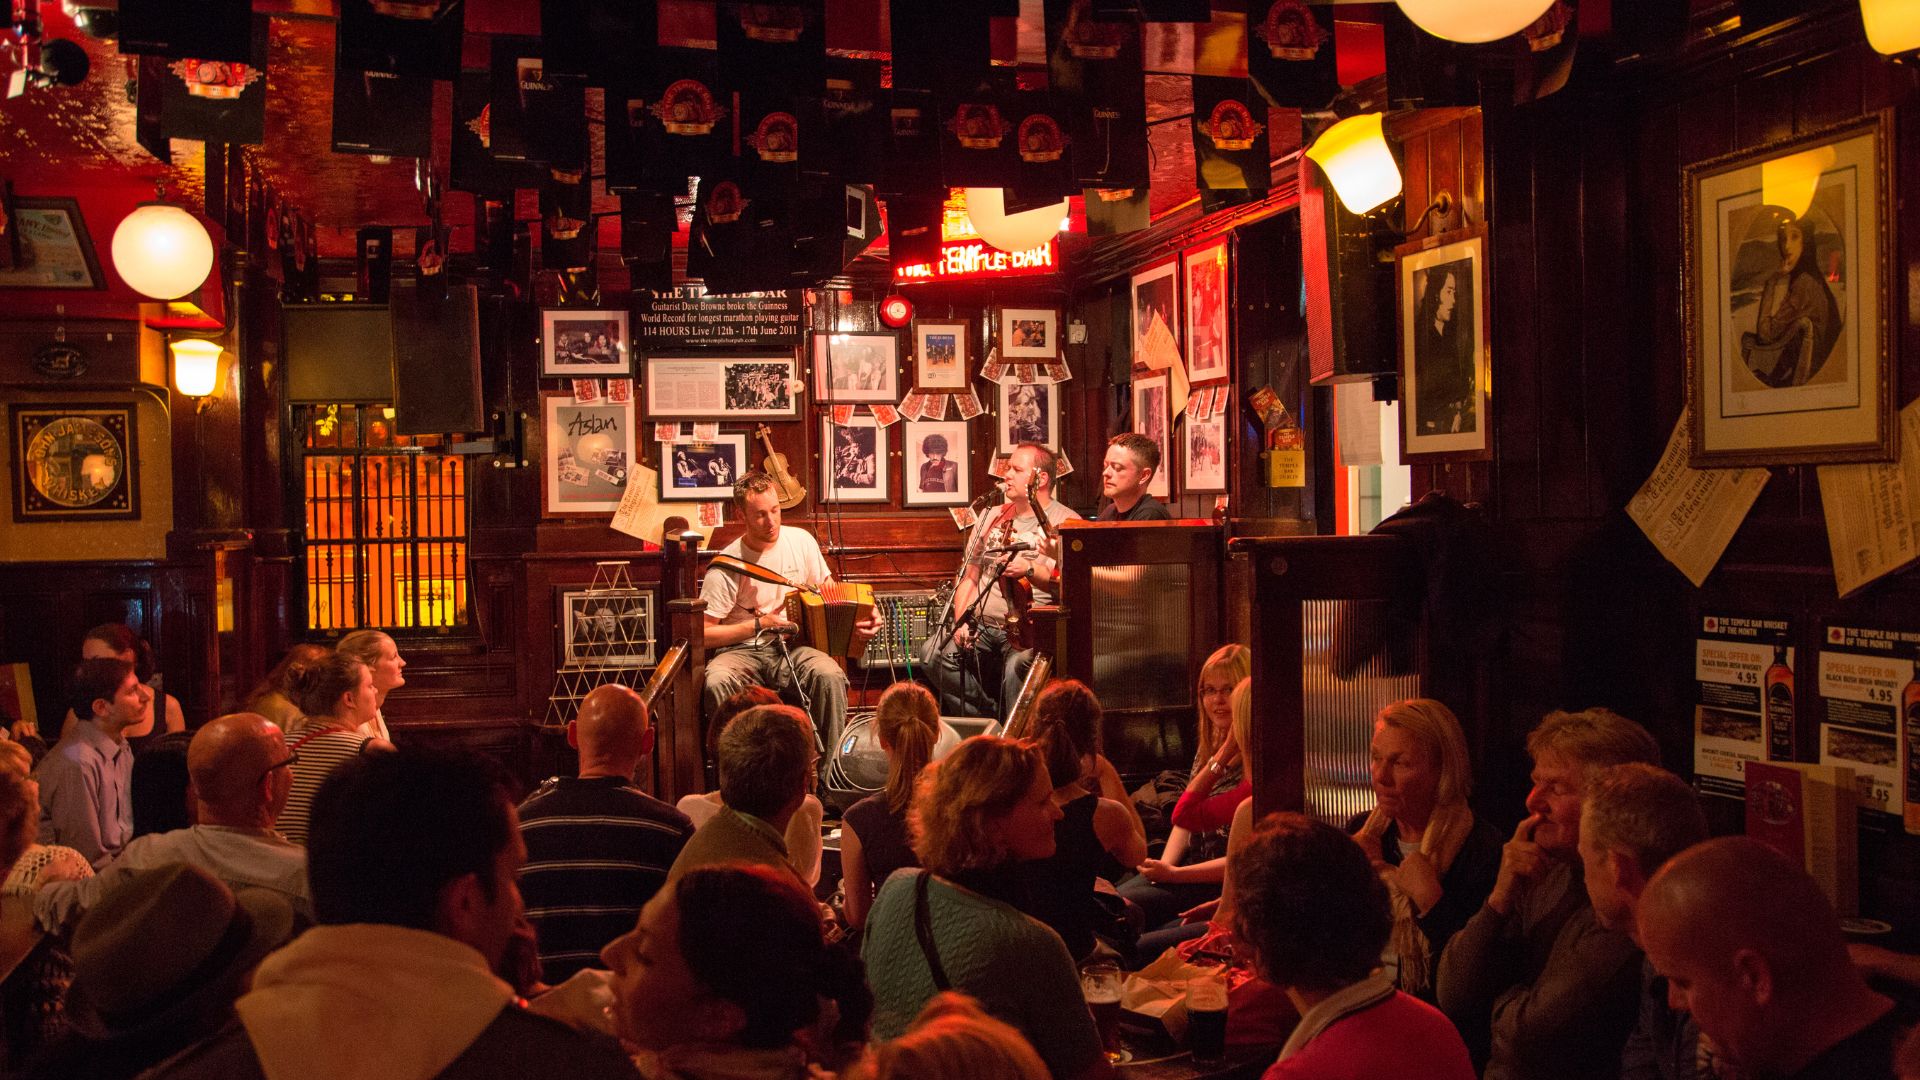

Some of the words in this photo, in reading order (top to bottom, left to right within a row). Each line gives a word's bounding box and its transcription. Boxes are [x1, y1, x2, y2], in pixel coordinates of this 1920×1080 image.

[651, 301, 680, 311] Guitarist
[682, 302, 699, 311] Dave
[700, 301, 725, 311] Browne
[726, 301, 745, 311] broke
[746, 301, 757, 310] the
[758, 301, 788, 310] Guinness
[641, 314, 660, 323] World
[662, 314, 685, 323] Record
[687, 314, 697, 323] for
[699, 313, 722, 325] longest
[723, 314, 753, 323] marathon
[754, 313, 778, 325] playing
[780, 313, 799, 325] guitar
[644, 326, 656, 336] 114
[659, 326, 690, 336] HOURS
[692, 326, 709, 336] Live
[718, 325, 733, 335] 12th
[743, 325, 758, 335] 17th
[760, 325, 777, 335] June
[779, 325, 797, 335] 2011
[567, 411, 618, 436] Aslan
[1719, 617, 1730, 626] THE
[1730, 618, 1751, 628] TEMPLE
[1751, 619, 1763, 629] BAR
[1763, 620, 1788, 631] WHISKEY
[1719, 626, 1726, 635] OF
[1727, 626, 1738, 636] THE
[1738, 627, 1758, 637] MONTH
[1846, 627, 1858, 638] THE
[1860, 629, 1884, 640] TEMPLE
[1885, 631, 1899, 641] BAR
[1846, 637, 1855, 646] OF
[1856, 638, 1869, 648] THE
[1869, 639, 1894, 650] MONTH
[1702, 649, 1727, 660] SPECIAL
[1728, 651, 1749, 662] OFFER
[1702, 659, 1716, 667] BLACK
[1826, 662, 1856, 675] SPECIAL
[1857, 665, 1882, 677] OFFER
[1825, 673, 1842, 682] BLACK
